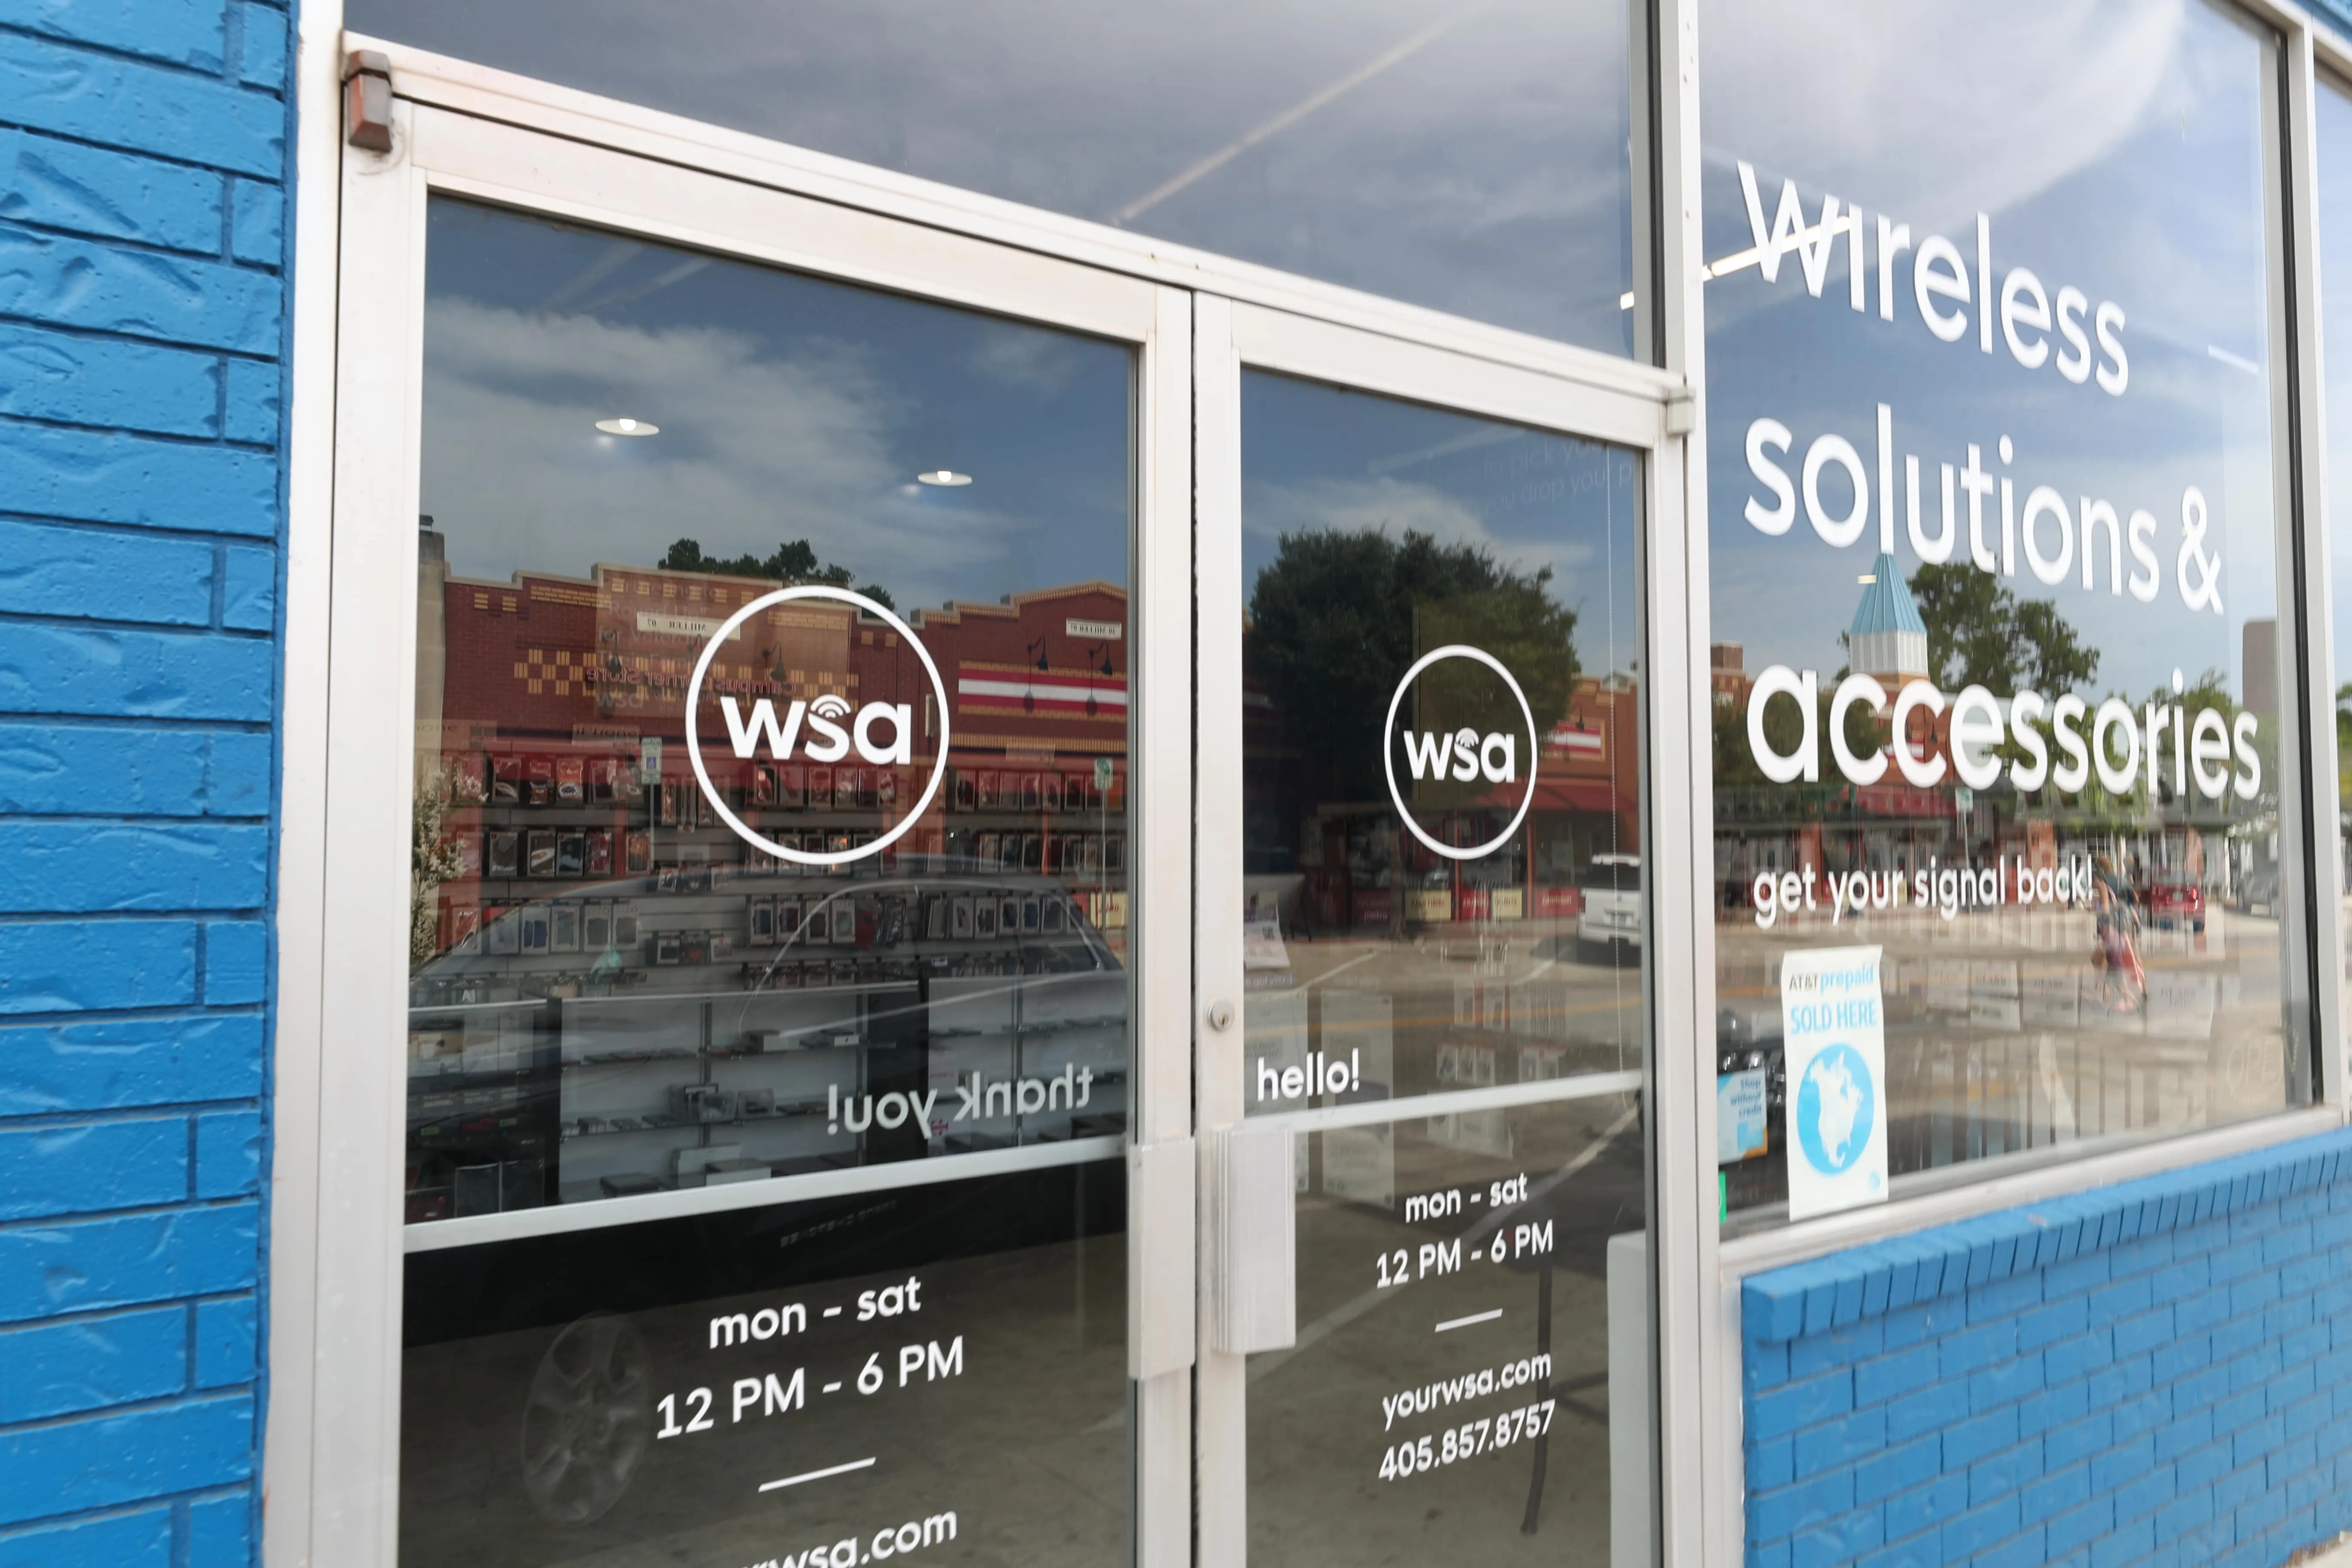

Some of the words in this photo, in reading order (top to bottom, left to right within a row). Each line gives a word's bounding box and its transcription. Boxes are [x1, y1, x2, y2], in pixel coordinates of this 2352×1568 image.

[1744, 402, 2160, 603] solutions
[2176, 485, 2224, 616] &
[720, 695, 911, 764] wsa
[1404, 728, 1515, 782] wsa
[1747, 665, 2261, 797] accessories
[1753, 862, 1816, 929] get
[1828, 870, 1904, 926] your
[1915, 855, 2005, 925] signal
[2017, 855, 2092, 903] back!
[1820, 962, 1874, 995] prepaid
[1790, 1002, 1833, 1035] SOLD
[1836, 998, 1877, 1029] HERE
[1257, 1048, 1360, 1102] hello!
[1406, 1189, 1461, 1223] mon
[1490, 1172, 1528, 1207] sat
[1377, 1249, 1409, 1289] 12
[1419, 1237, 1461, 1279] PM
[1491, 1229, 1507, 1263] 6
[1515, 1219, 1553, 1259] PM
[710, 1303, 806, 1349] mon
[857, 1276, 921, 1321] sat
[657, 1387, 714, 1439] 12
[733, 1367, 805, 1423] PM
[857, 1352, 884, 1395] 6
[899, 1335, 963, 1387] PM
[1382, 1354, 1551, 1432] yourwsa.com
[1378, 1399, 1556, 1481] 405.857.8757
